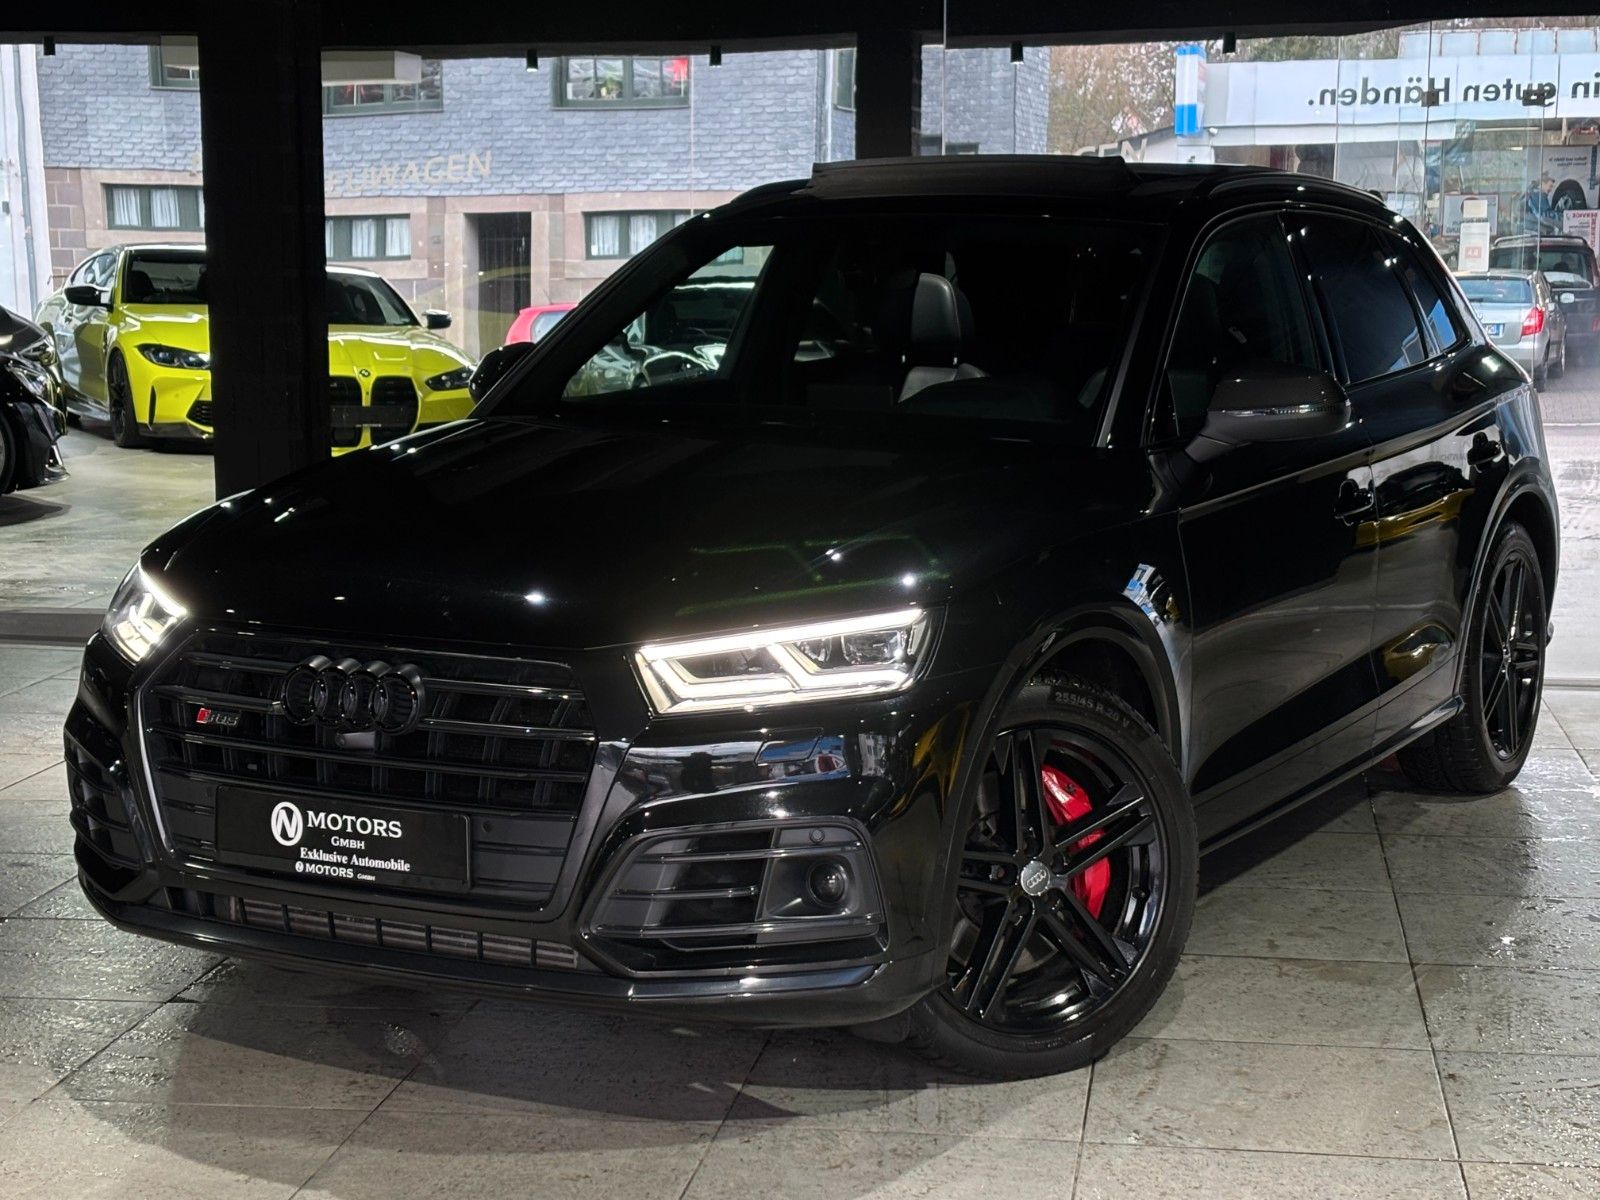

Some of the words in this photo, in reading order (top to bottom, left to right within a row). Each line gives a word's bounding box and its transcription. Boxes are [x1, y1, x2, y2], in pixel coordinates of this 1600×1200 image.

[306, 810, 403, 838] MOTORS
[299, 847, 349, 865] Exklusive
[350, 854, 411, 872] Automobile
[305, 862, 355, 879] MOTORS
